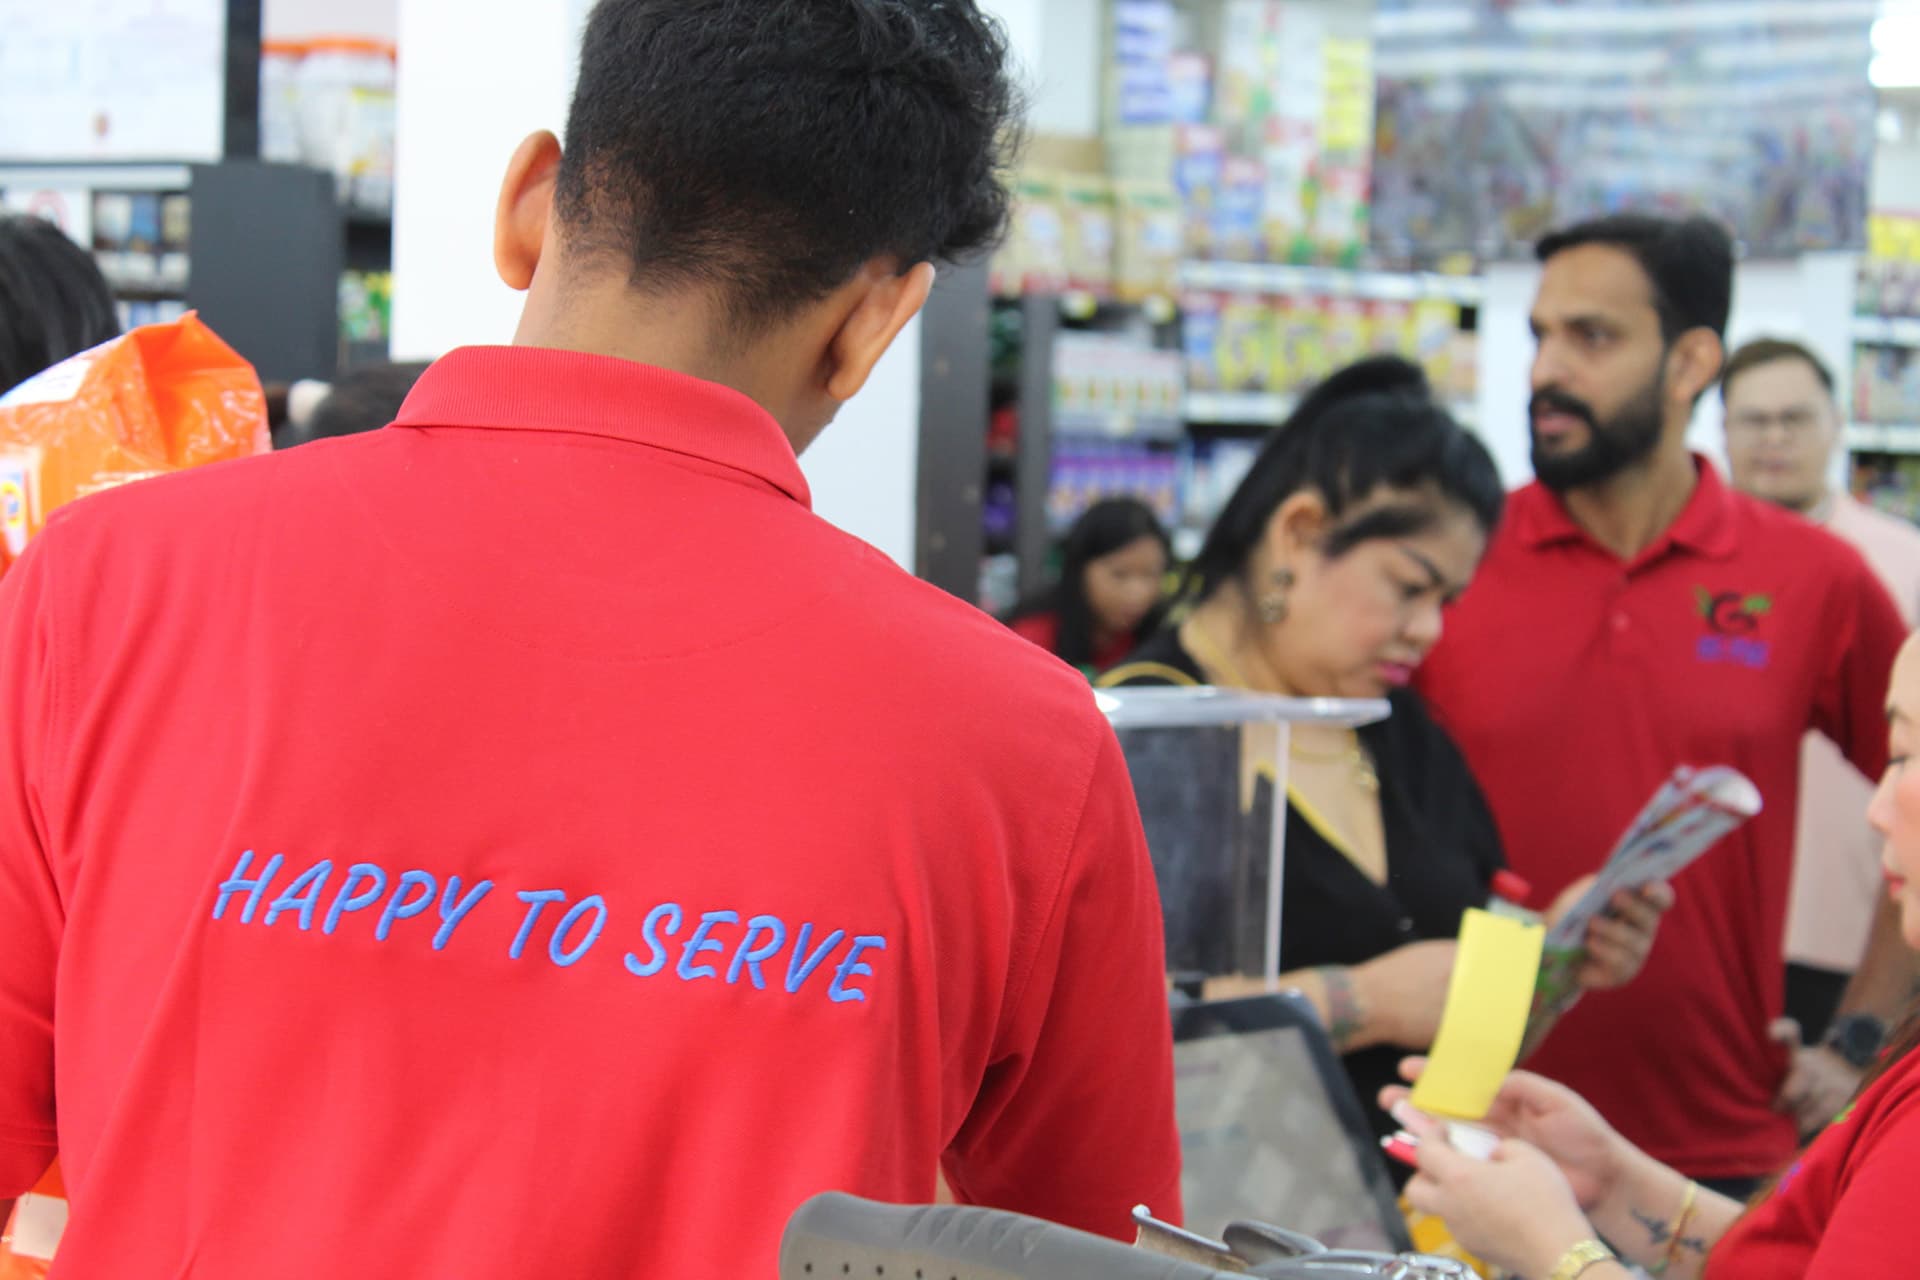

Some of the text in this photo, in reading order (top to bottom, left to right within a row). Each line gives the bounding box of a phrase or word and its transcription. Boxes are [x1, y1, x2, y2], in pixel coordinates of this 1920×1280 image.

[212, 849, 886, 1003] HAPPY TO SERVE
